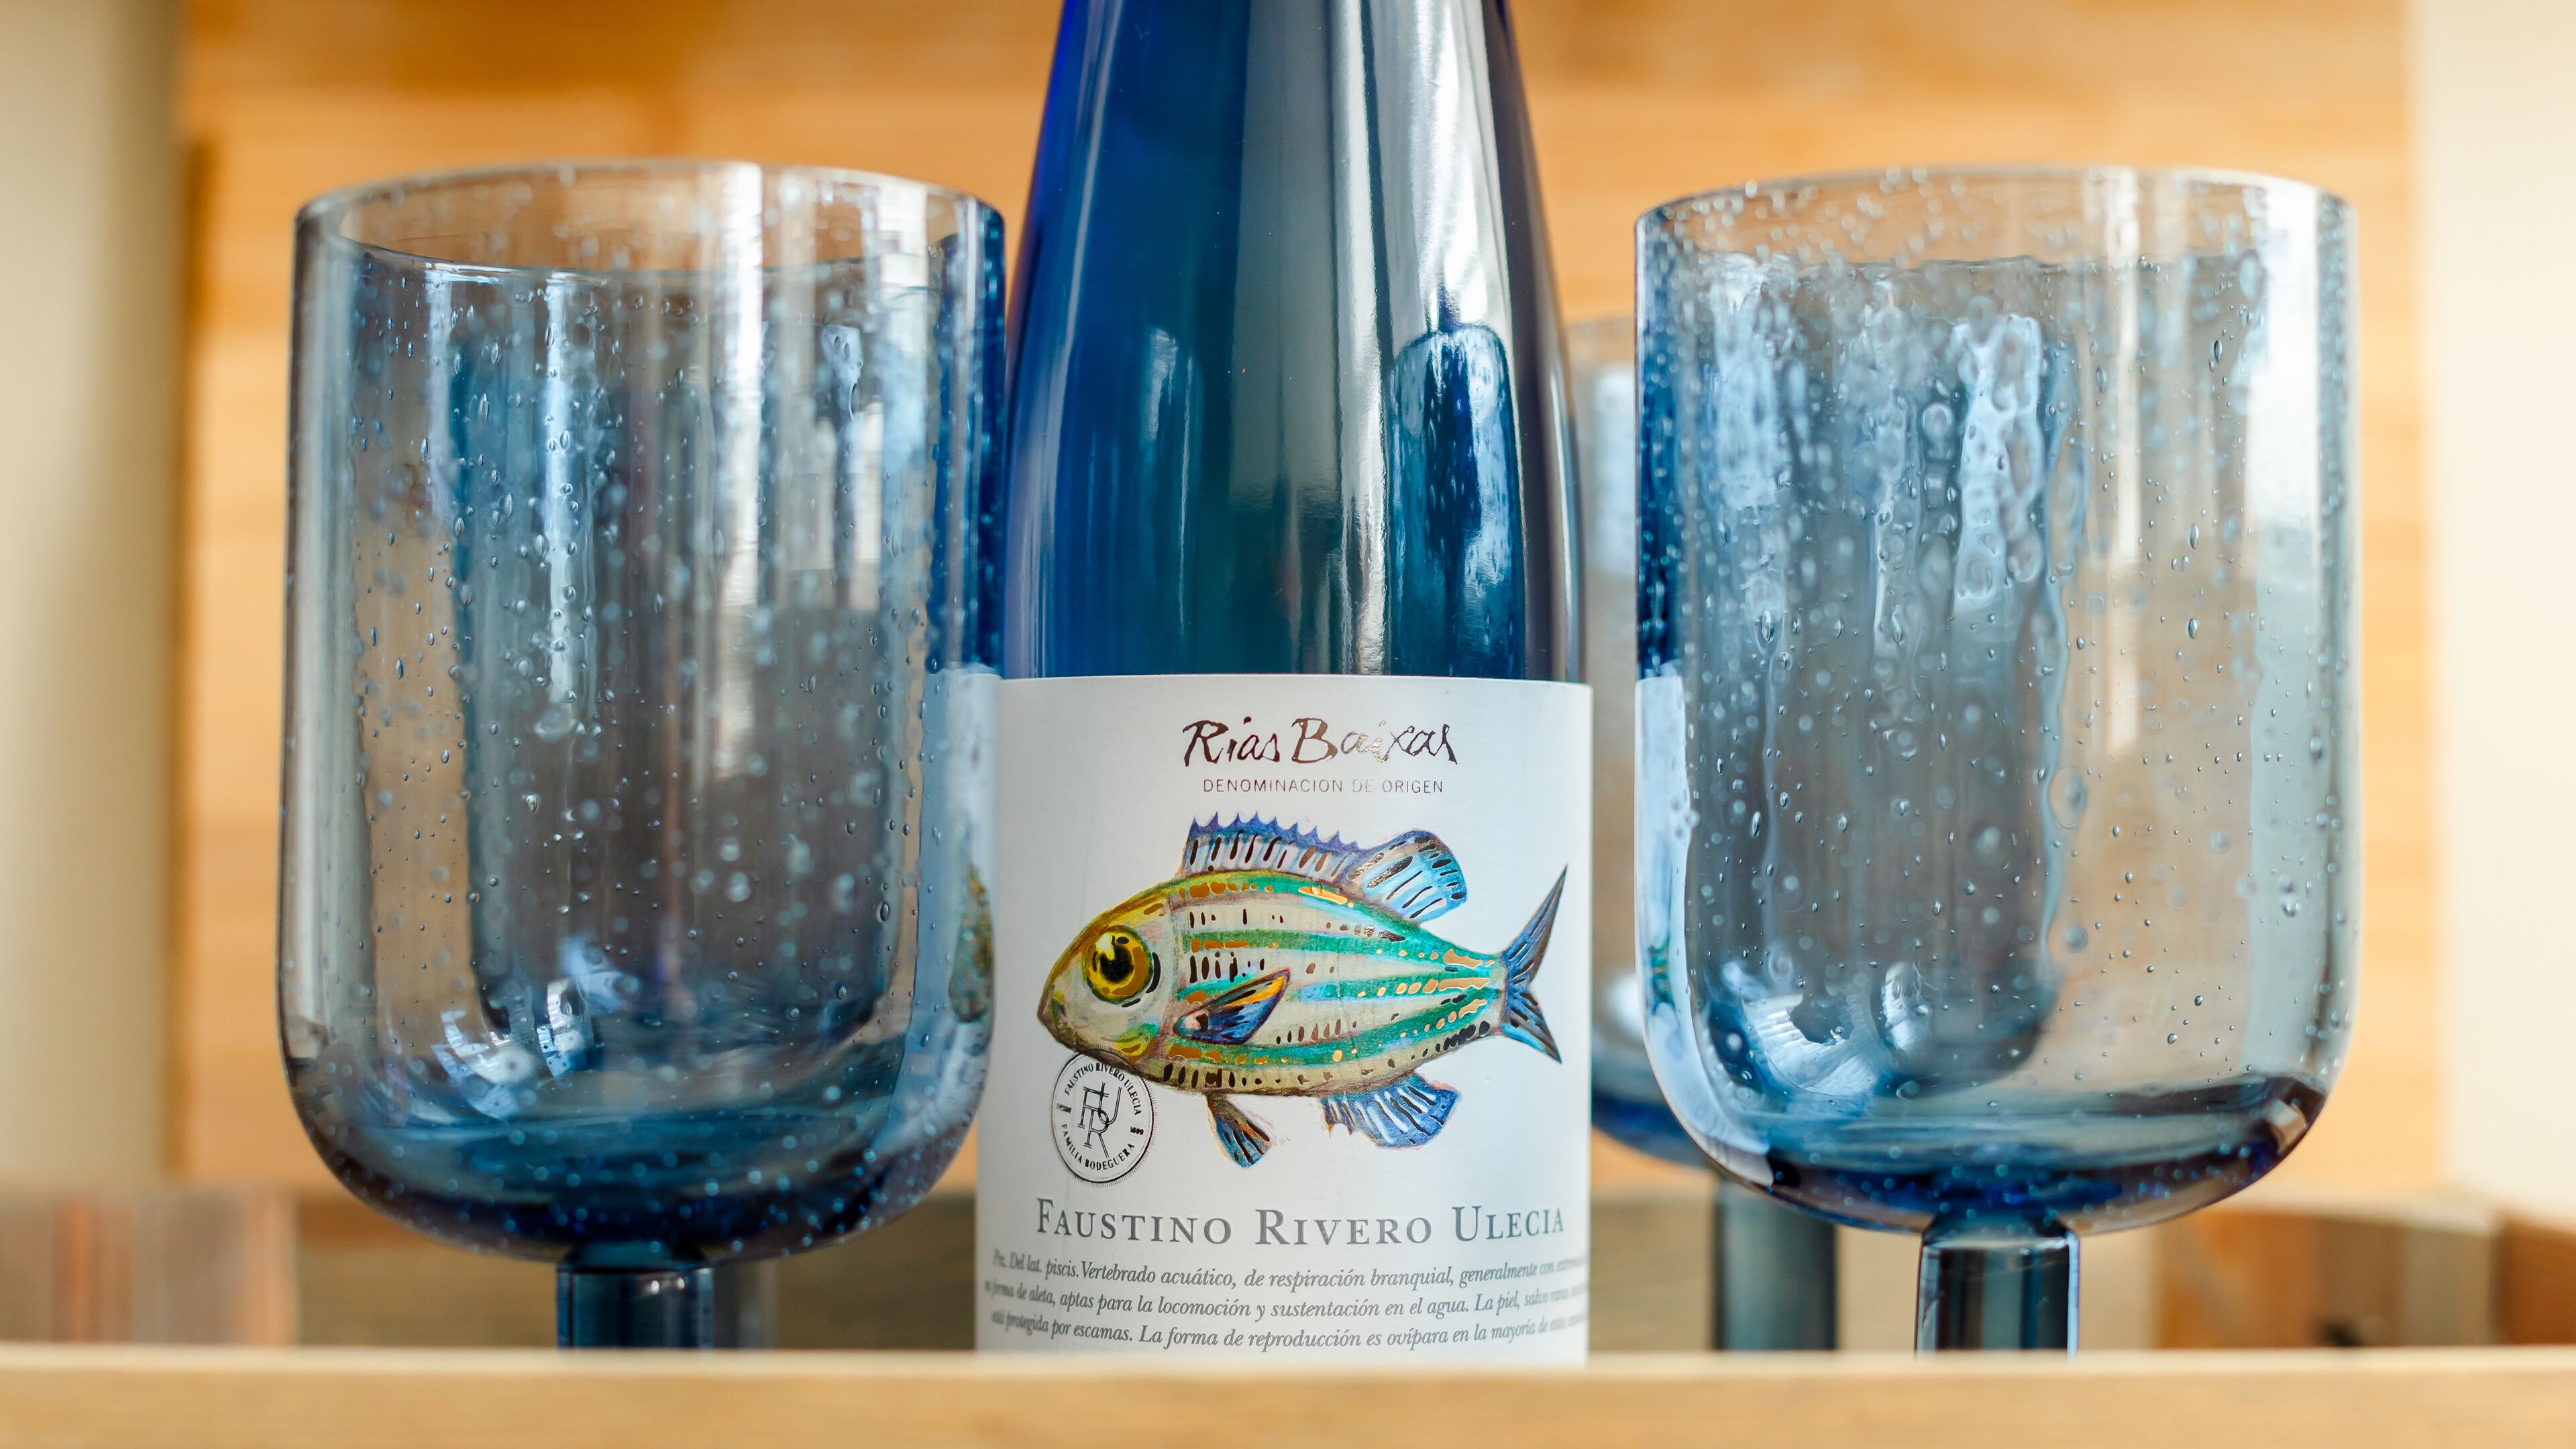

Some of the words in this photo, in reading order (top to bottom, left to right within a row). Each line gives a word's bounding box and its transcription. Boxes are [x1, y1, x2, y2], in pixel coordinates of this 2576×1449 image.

[1291, 717, 1458, 765] Baixas
[1203, 779, 1342, 793] DENOMINACION
[1352, 779, 1374, 794] DE
[1382, 780, 1443, 794] ORIGEN
[1064, 1063, 1094, 1095] FAUSTINO
[1095, 1063, 1125, 1082] RIVERO
[1124, 1079, 1142, 1116] ULECIA
[1061, 1124, 1082, 1164] FAMILIA
[1084, 1142, 1135, 1171] BODEGUERA
[1036, 1197, 1232, 1245] FAUSTINO
[1254, 1208, 1432, 1246] RIVERO
[1451, 1205, 1564, 1242] ULECIA
[1009, 1252, 1025, 1270] Del
[1027, 1254, 1042, 1273] lat.
[1045, 1258, 1079, 1280] piscis.
[1081, 1260, 1156, 1283] Vertebrado
[1161, 1268, 1237, 1289] acuático,
[1244, 1269, 1265, 1287] de
[1269, 1269, 1366, 1293] respiración
[1371, 1266, 1454, 1291] branquial,
[1458, 1262, 1538, 1288] generalmente
[1029, 1285, 1056, 1307] aleta,
[1060, 1291, 1094, 1311] aptas
[1095, 1294, 1133, 1315] para
[1137, 1295, 1153, 1313] la
[1158, 1295, 1251, 1316] locomoción
[1254, 1305, 1266, 1322] y
[1271, 1299, 1380, 1317] sustentación
[1385, 1303, 1405, 1316] en
[1409, 1297, 1424, 1315] el
[1426, 1299, 1469, 1320] agua.
[1474, 1293, 1494, 1311] La
[1495, 1290, 1520, 1316] piel,
[1051, 1319, 1071, 1340] por
[1073, 1324, 1133, 1342] escamas.
[1138, 1324, 1163, 1343] La
[1163, 1326, 1218, 1350] forma
[1224, 1328, 1244, 1346] de
[1248, 1329, 1362, 1353] reproducción
[1366, 1334, 1383, 1346] es
[1387, 1327, 1449, 1351] ovípara
[1452, 1330, 1470, 1342] en
[1473, 1324, 1487, 1341] la
[1491, 1318, 1536, 1344] mayoría
